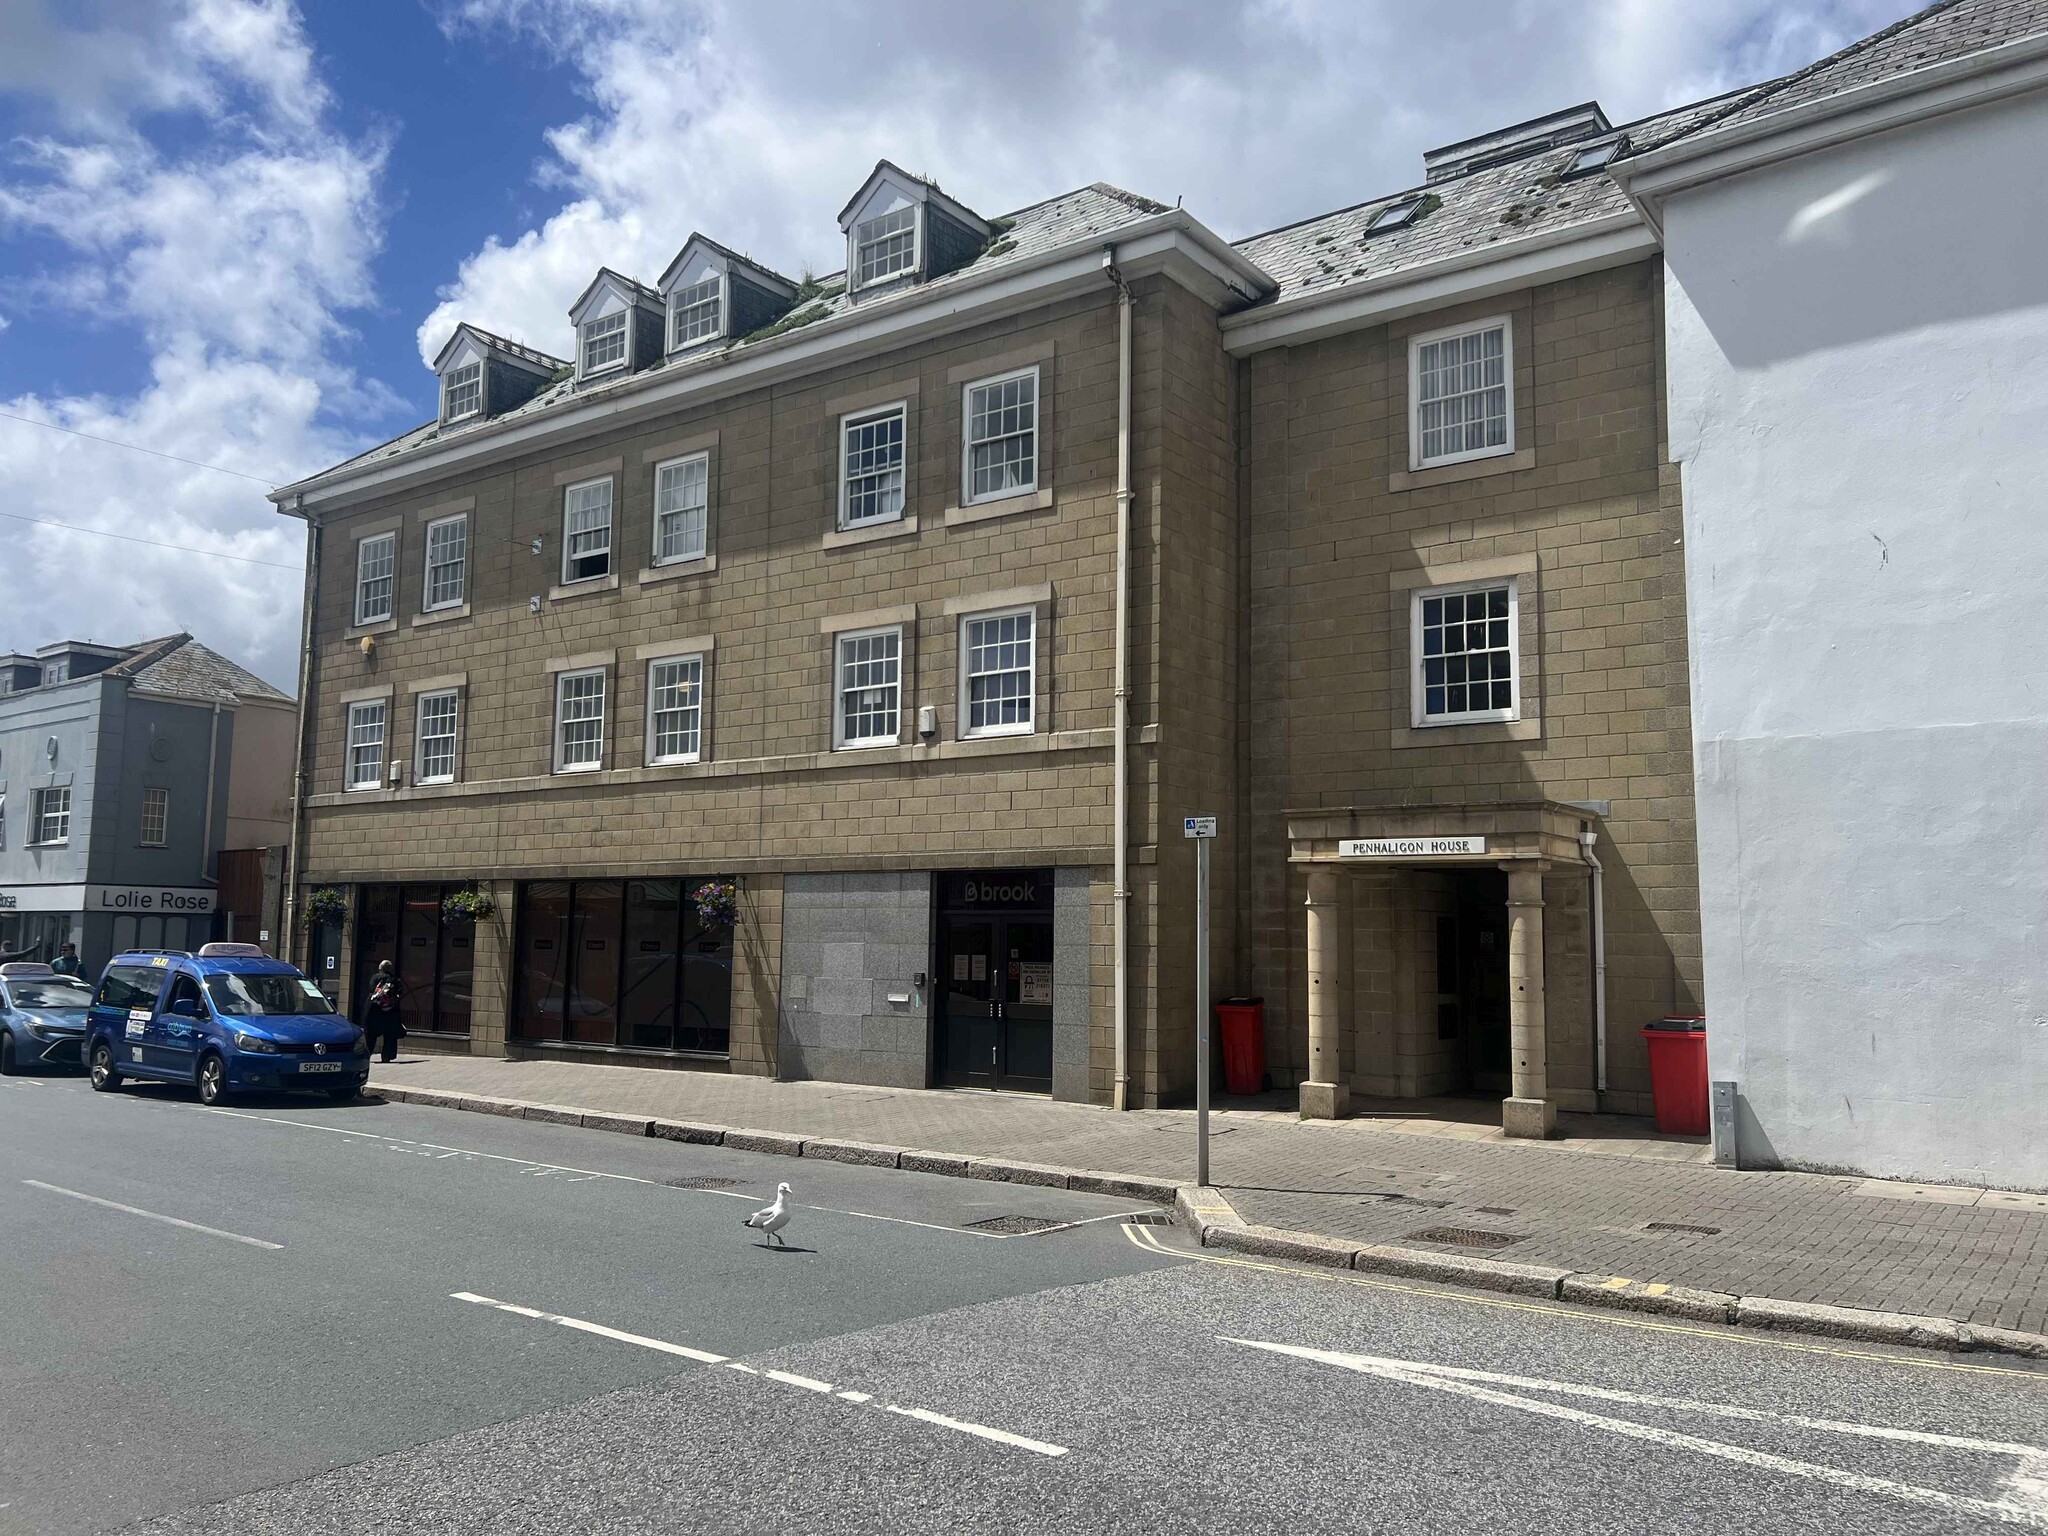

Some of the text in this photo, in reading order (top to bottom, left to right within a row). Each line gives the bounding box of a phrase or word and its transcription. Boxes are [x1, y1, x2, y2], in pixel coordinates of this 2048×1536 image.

[1352, 841, 1470, 853] PENHALIGON HOUSE
[981, 881, 1035, 901] brook
[102, 889, 209, 909] Lolie Rose
[151, 956, 170, 966] TAXI
[303, 1063, 338, 1072] SF12 GZY
